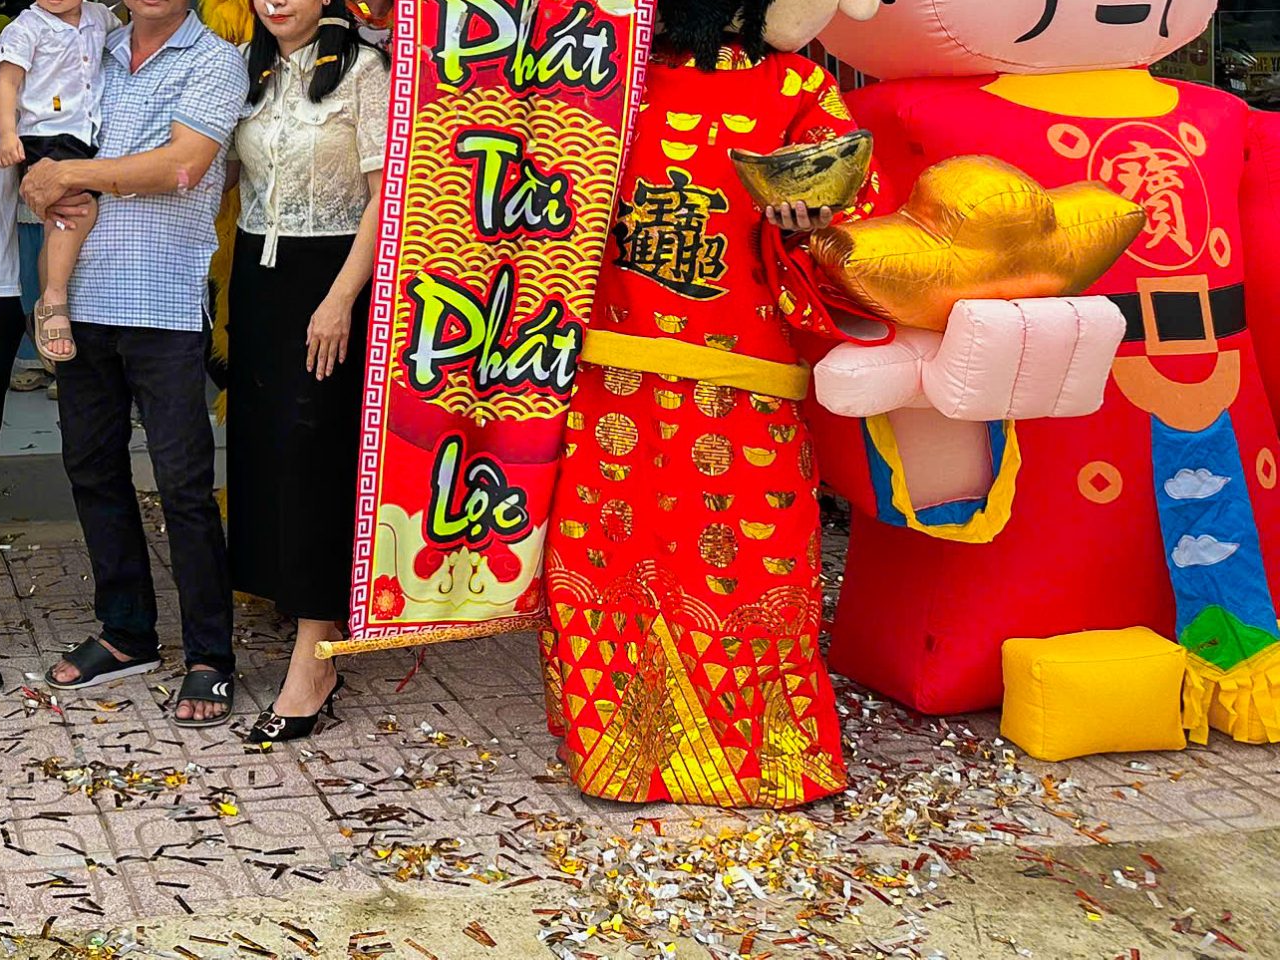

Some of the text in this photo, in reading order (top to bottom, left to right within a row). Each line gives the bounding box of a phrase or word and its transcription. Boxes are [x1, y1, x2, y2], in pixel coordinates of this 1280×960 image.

[458, 135, 567, 231] Tài
[407, 270, 577, 389] Phát
[431, 440, 523, 538] Lộc
